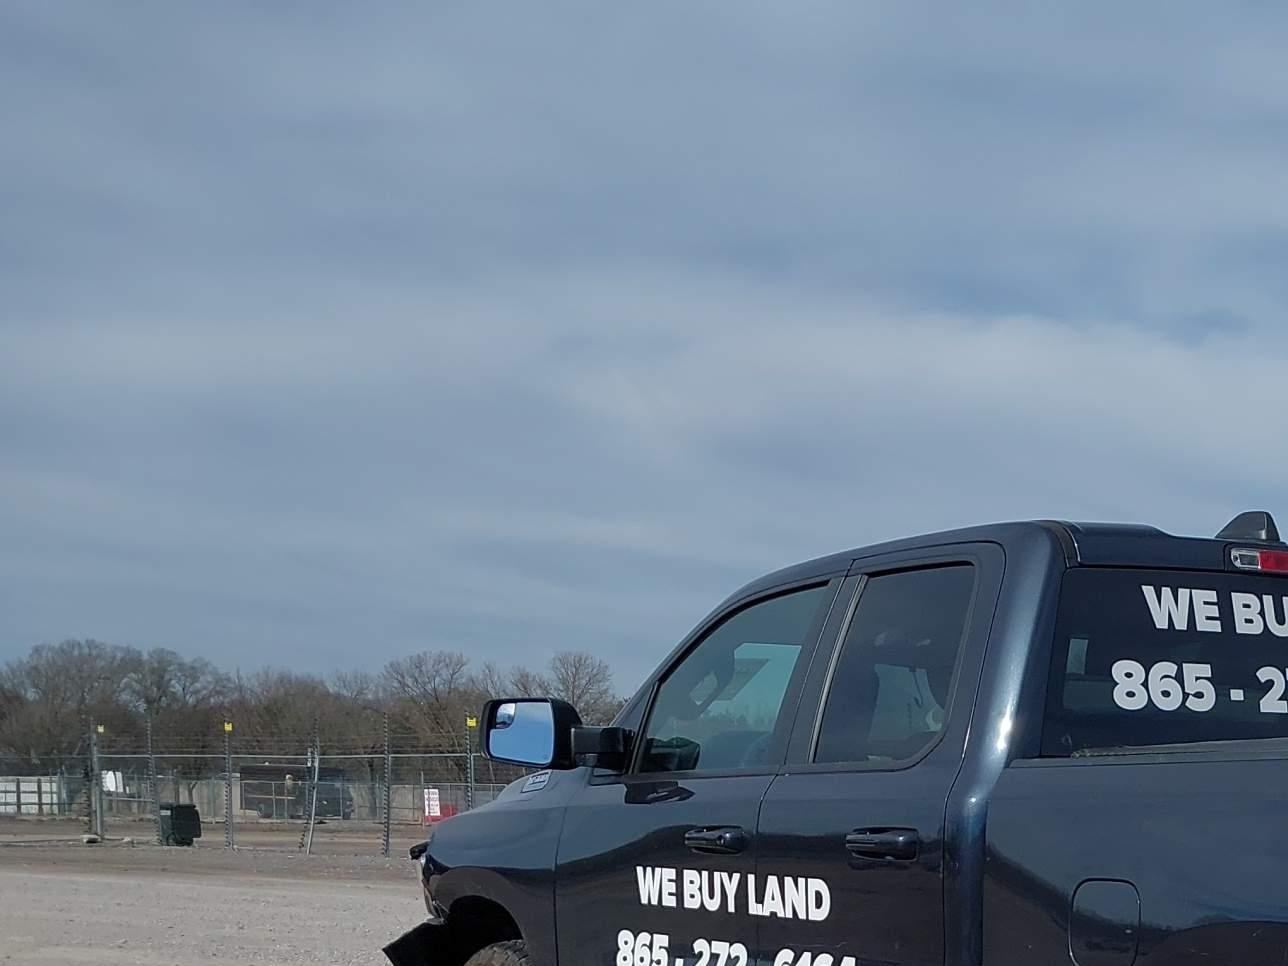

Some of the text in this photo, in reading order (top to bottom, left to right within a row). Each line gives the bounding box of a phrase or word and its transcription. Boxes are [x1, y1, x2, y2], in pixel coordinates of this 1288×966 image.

[1141, 585, 1222, 633] WE
[1111, 659, 1216, 712] 865
[636, 865, 831, 921] WE BUY LAND
